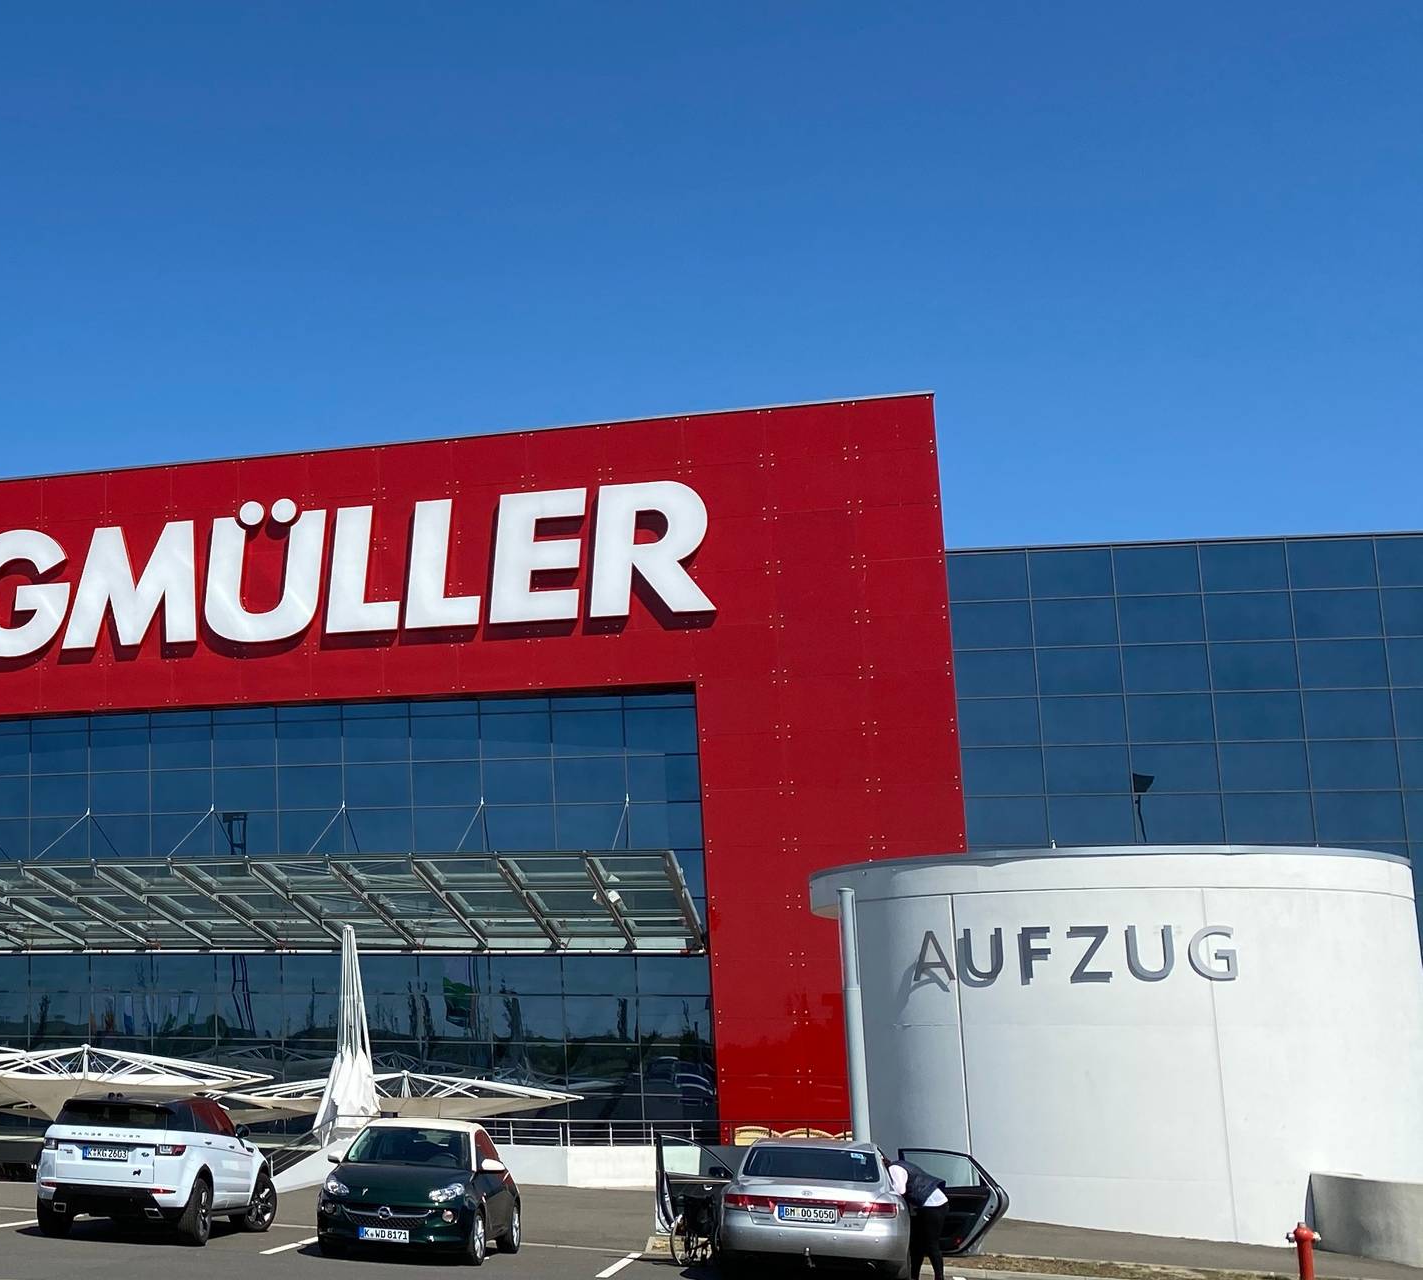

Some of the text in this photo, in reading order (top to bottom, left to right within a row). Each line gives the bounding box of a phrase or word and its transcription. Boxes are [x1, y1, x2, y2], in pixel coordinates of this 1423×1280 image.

[912, 924, 1240, 984] AUFZUG
[784, 1207, 796, 1217] BM
[813, 1210, 834, 1220] 5050
[375, 1229, 386, 1239] WD
[387, 1230, 408, 1240] 8171
